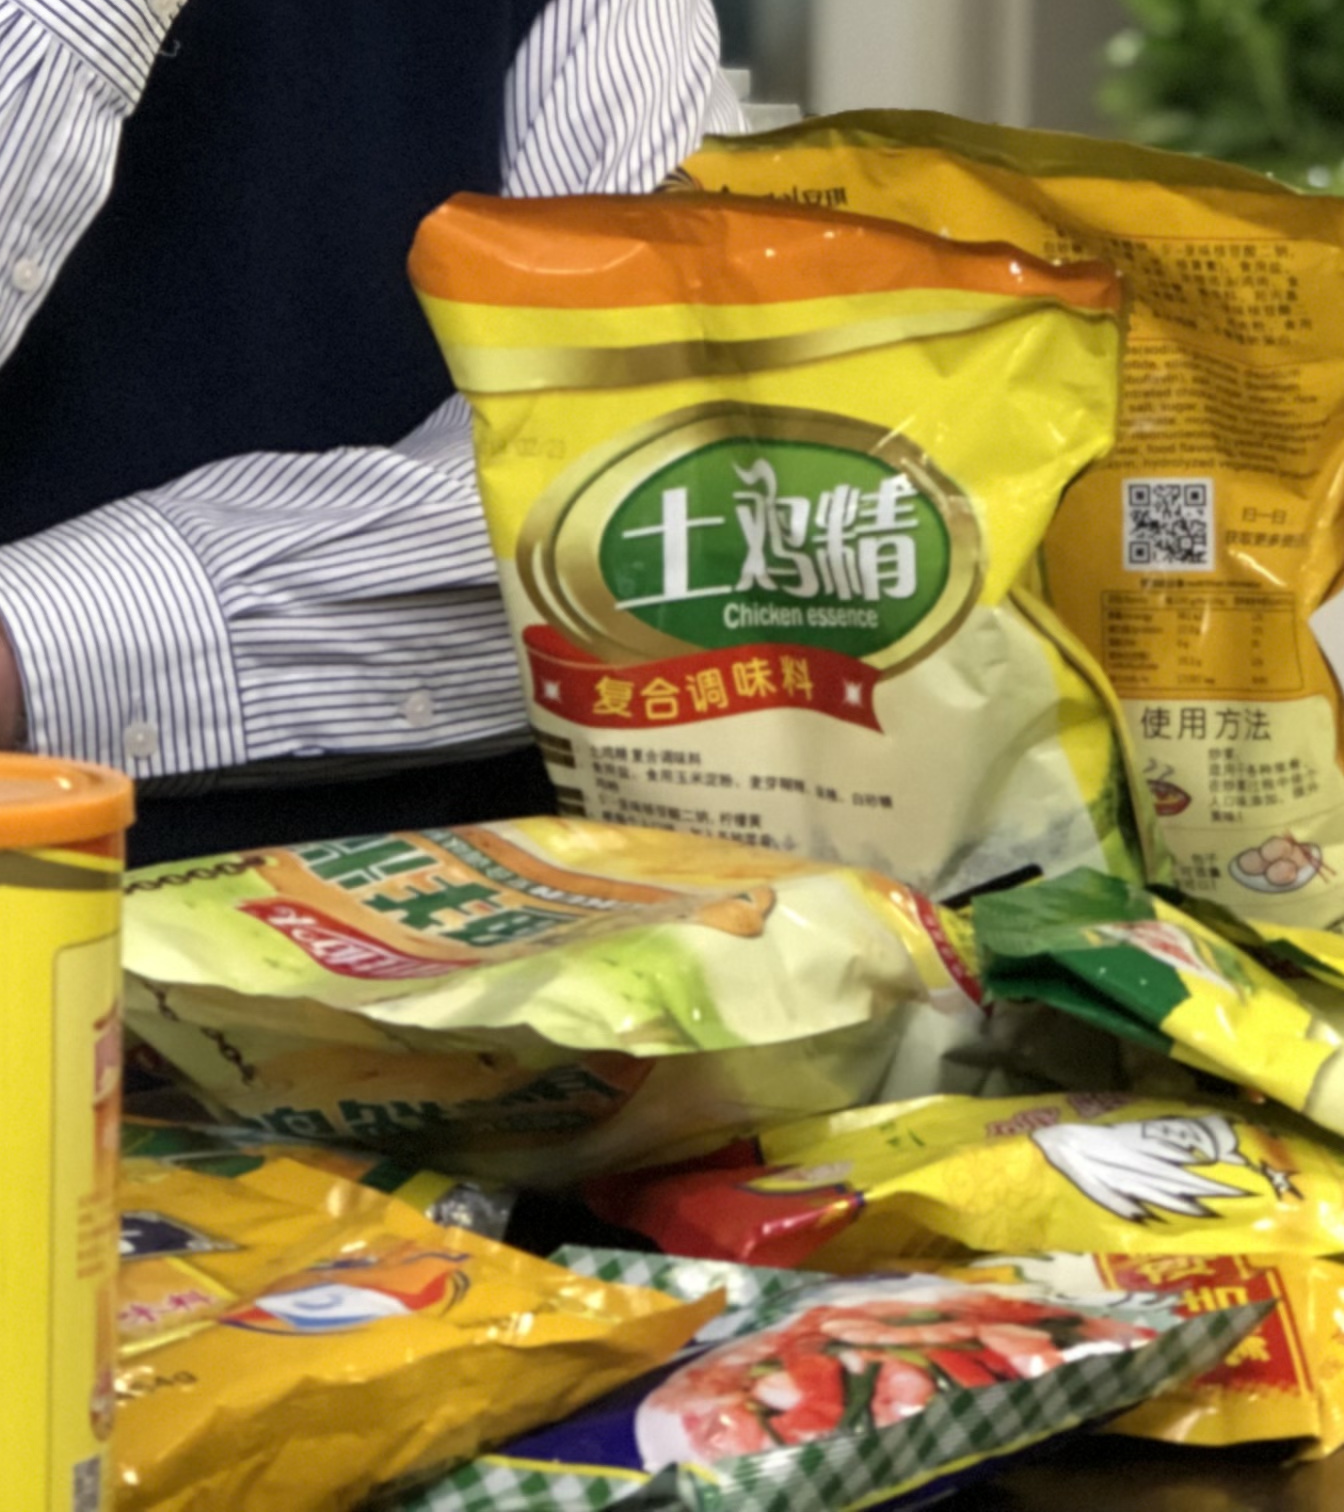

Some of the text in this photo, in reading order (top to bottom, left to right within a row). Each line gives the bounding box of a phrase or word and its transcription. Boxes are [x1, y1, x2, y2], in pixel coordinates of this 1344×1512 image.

[615, 458, 920, 610] 土鸡精
[722, 602, 879, 629] Chicken essence
[592, 655, 815, 721] 复合调味料
[1140, 706, 1272, 741] 使用方法
